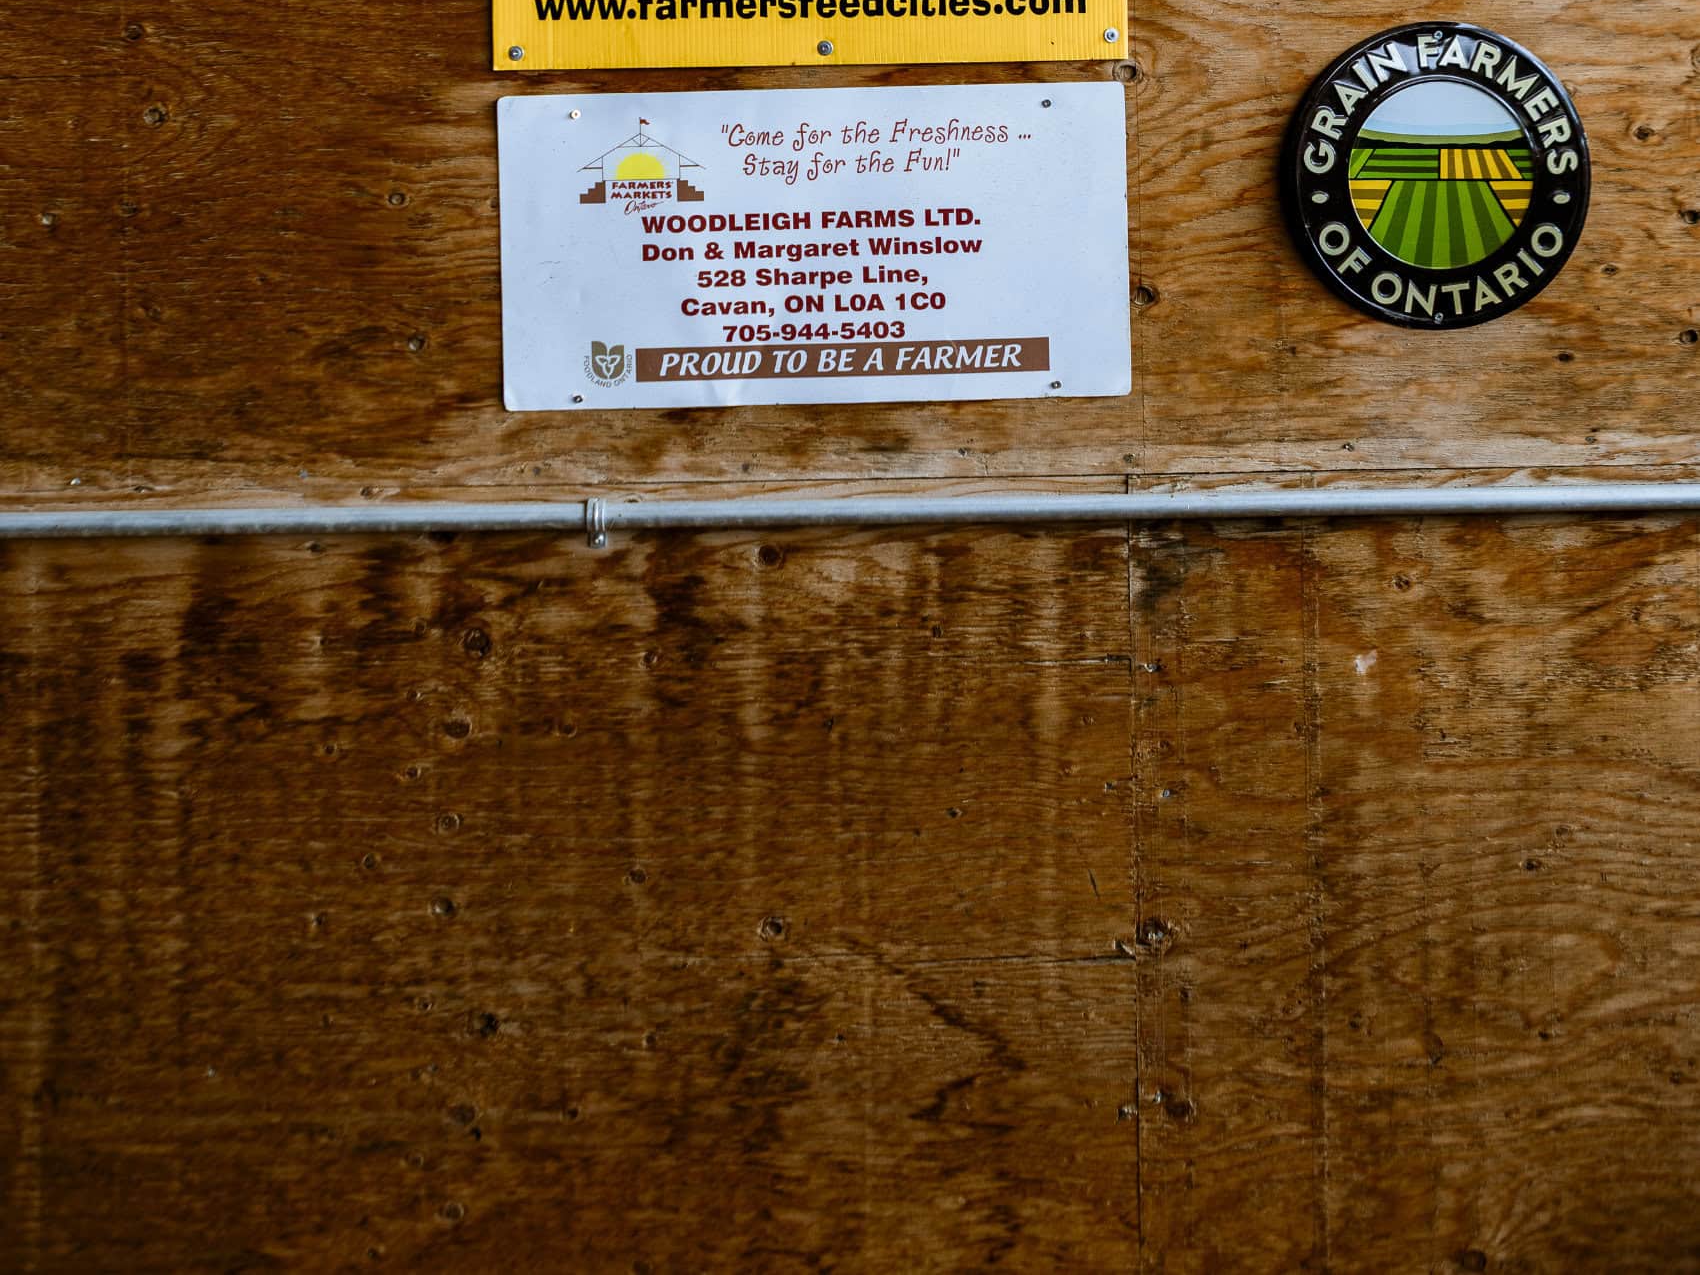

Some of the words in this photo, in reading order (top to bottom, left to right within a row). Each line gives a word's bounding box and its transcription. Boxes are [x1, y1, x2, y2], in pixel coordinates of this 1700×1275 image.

[1303, 41, 1408, 175] GRAIN
[1416, 33, 1579, 175] FARMERS
[792, 123, 832, 151] for
[840, 122, 880, 144] the
[889, 118, 1009, 143] Freshness
[742, 153, 799, 185] Stay
[806, 152, 846, 181] for
[856, 150, 895, 173] the
[903, 147, 960, 172] Fun!"
[610, 191, 672, 200] MARKETS
[641, 212, 811, 234] WOODLEIGH
[821, 209, 915, 229] FARMS
[924, 208, 981, 226] LTD.
[641, 243, 694, 262] Don
[704, 242, 724, 260] &
[733, 238, 859, 262] Margaret
[868, 236, 982, 256] Winslow
[697, 270, 747, 288] 528
[755, 267, 853, 289] Sharpe
[862, 265, 928, 286] Line,
[1319, 221, 1372, 275] OF
[1371, 222, 1564, 317] ONTARIO
[680, 297, 775, 317] Cavan,
[783, 294, 824, 313] ON
[722, 320, 906, 343] 705-944-5403
[659, 349, 763, 377] PROUD
[772, 348, 807, 373] TO
[816, 347, 857, 373] BE
[863, 346, 885, 372] A
[894, 342, 1023, 370] FARMER
